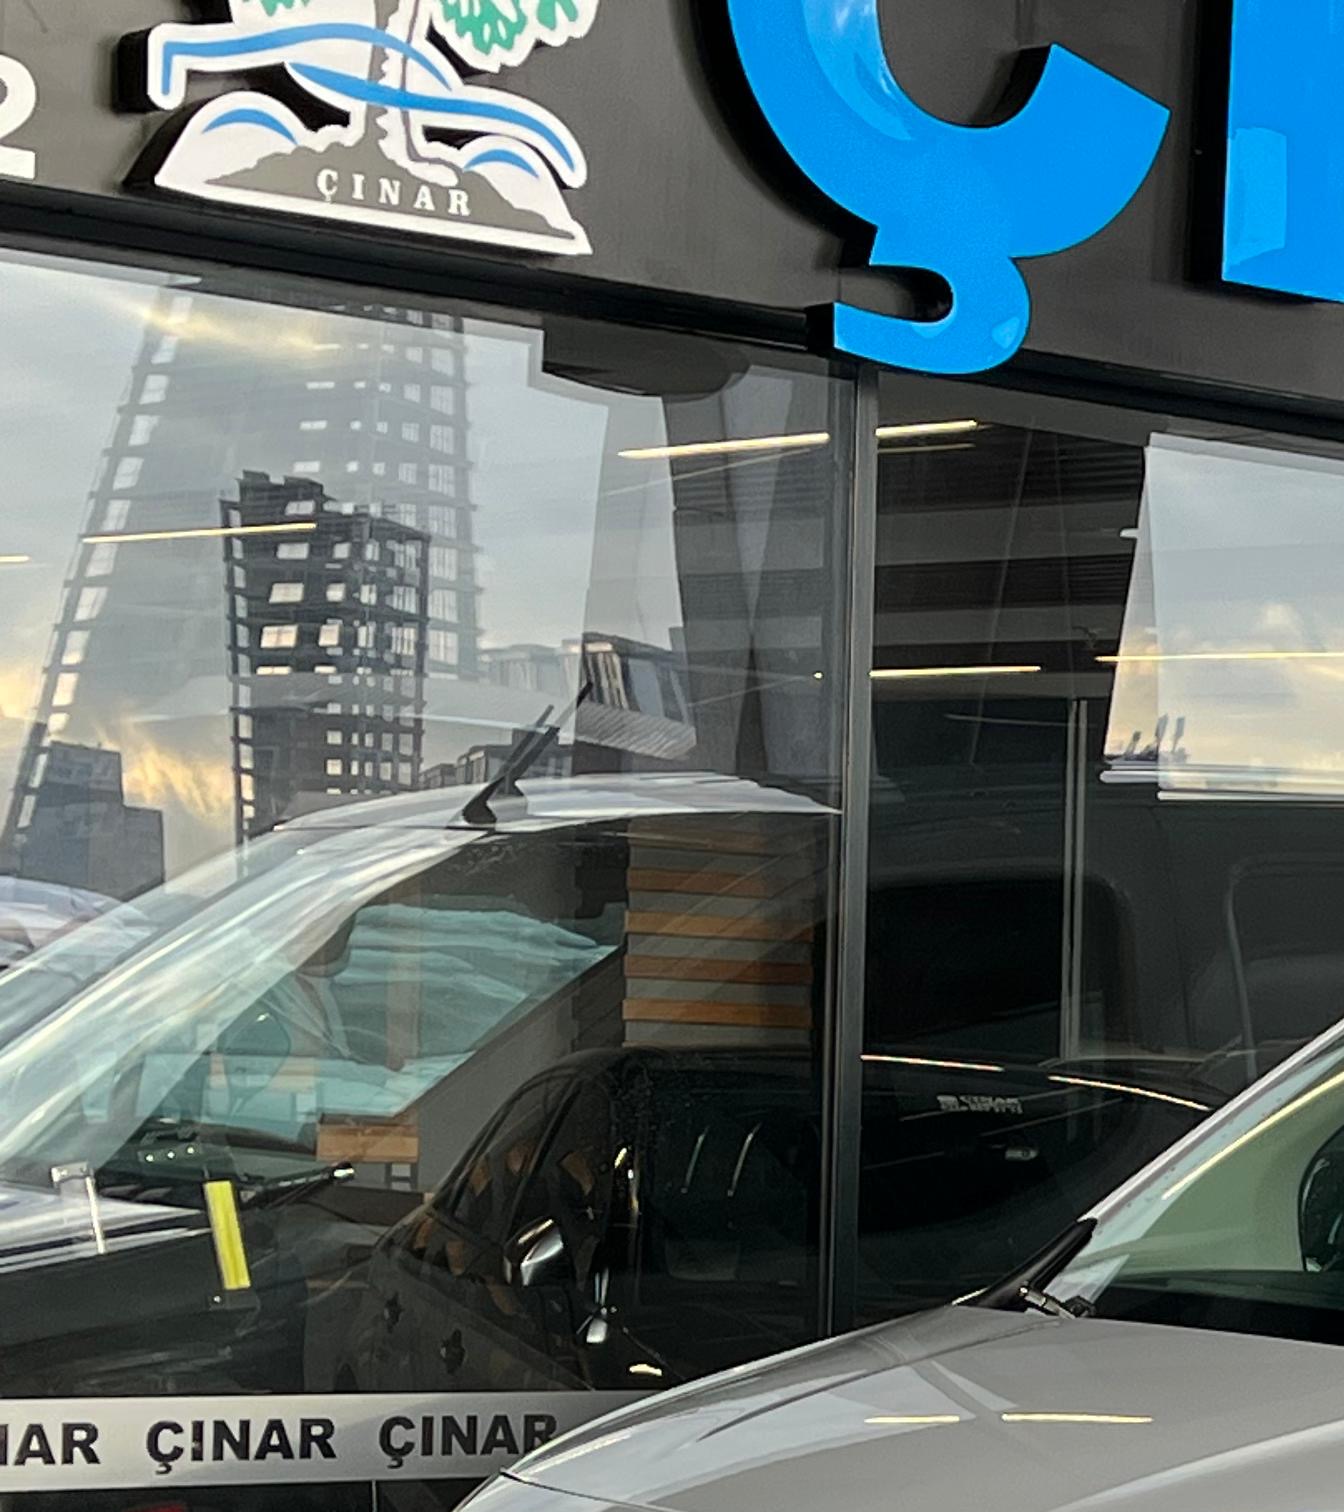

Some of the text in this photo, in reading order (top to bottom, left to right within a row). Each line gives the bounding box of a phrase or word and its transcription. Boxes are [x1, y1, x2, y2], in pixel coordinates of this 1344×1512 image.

[317, 168, 472, 217] ÇINAR
[0, 1414, 557, 1475] AR ÇINAR ÇINAR
